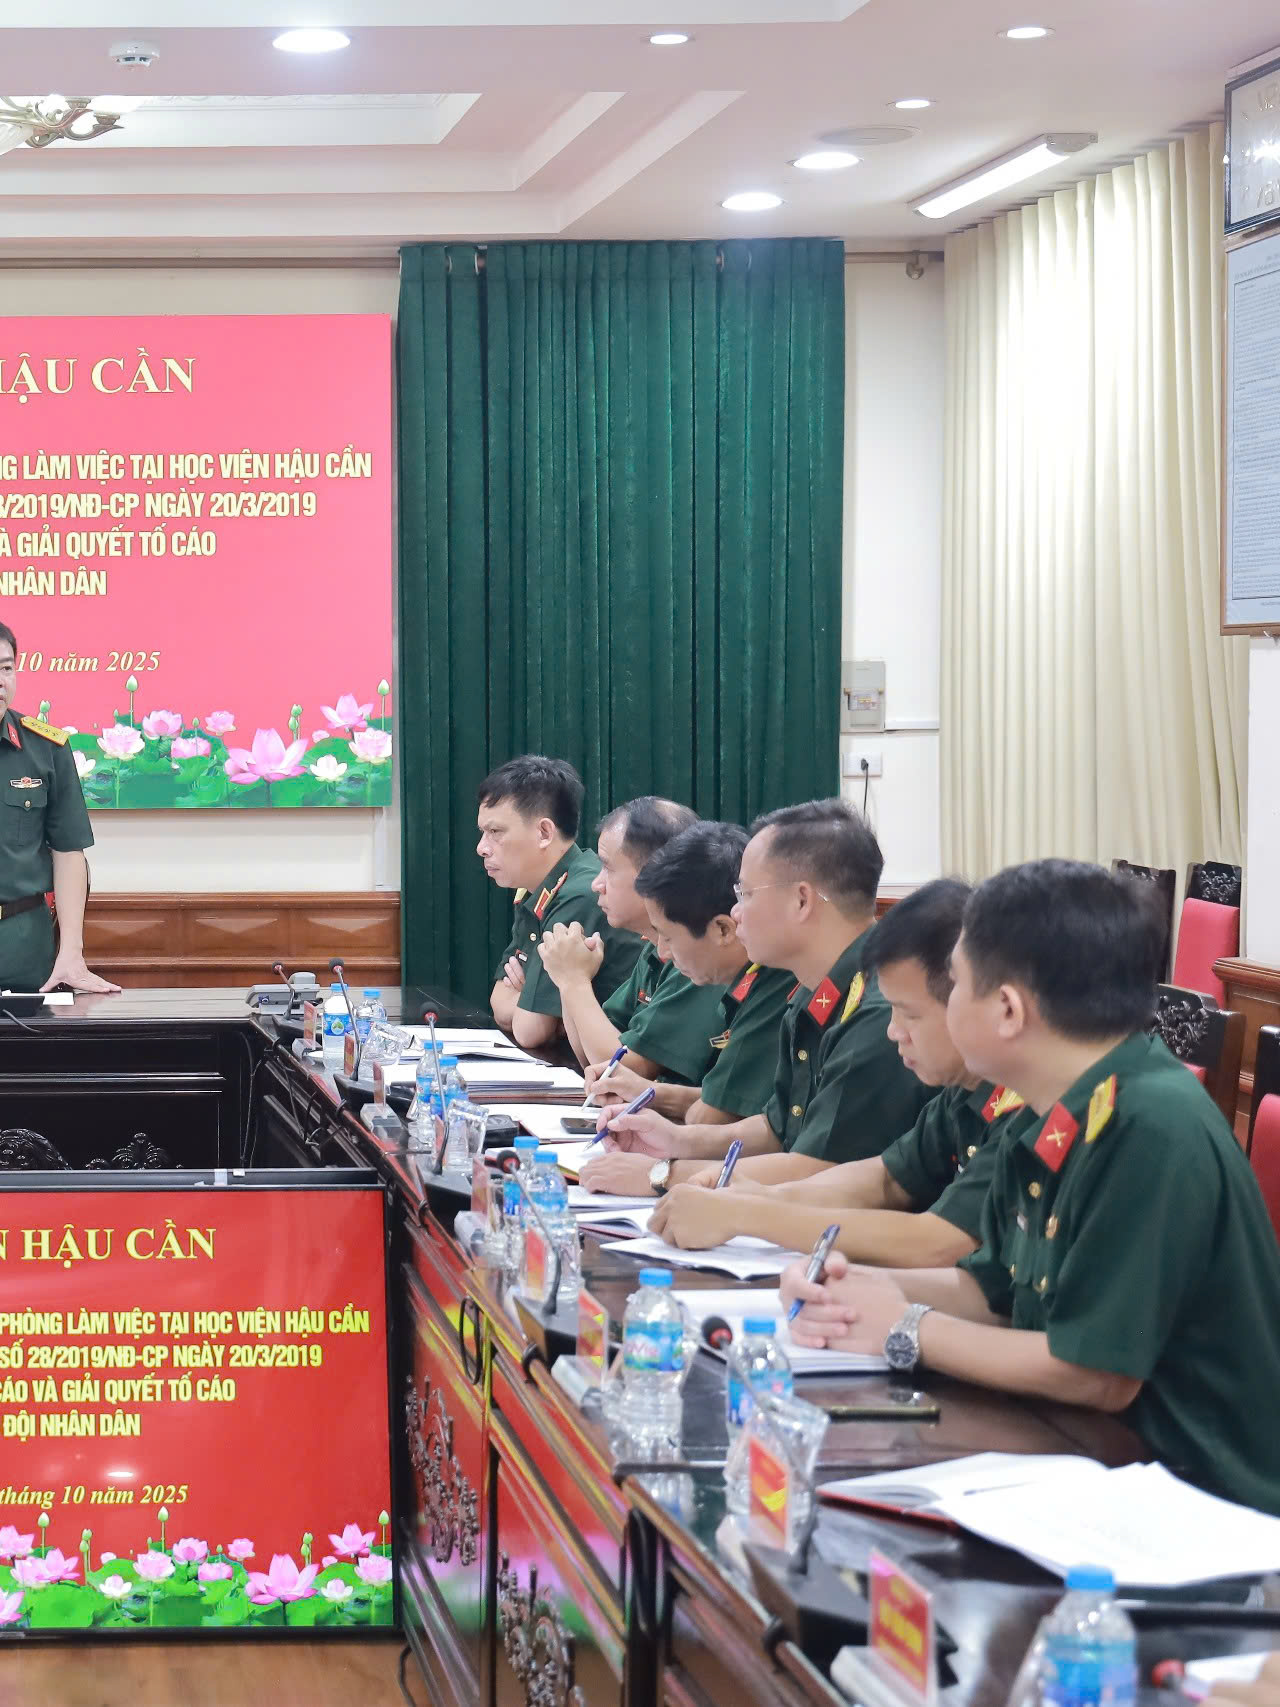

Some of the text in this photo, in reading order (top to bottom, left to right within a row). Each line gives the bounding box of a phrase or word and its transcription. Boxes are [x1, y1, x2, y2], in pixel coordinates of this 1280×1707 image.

[92, 347, 195, 393] CẦN
[23, 450, 70, 479] LÀM
[76, 450, 124, 485] VIỆC
[130, 455, 163, 484] TẠI
[170, 454, 213, 484] HỌC
[219, 449, 269, 484] VIỆN
[275, 449, 319, 483] HẬU
[326, 444, 371, 478] CẦN
[145, 487, 205, 518] NGÀY
[210, 492, 316, 517] 20/3/2019
[17, 524, 60, 557] GIẢI
[66, 523, 134, 559] QUYẾT
[139, 523, 166, 556] TỐ
[172, 527, 216, 556] CÁO
[60, 566, 106, 595] DÂN
[16, 652, 42, 672] 10
[49, 653, 98, 672] năm
[106, 652, 160, 672] 2025
[21, 1224, 114, 1268] HẬU
[126, 1219, 216, 1259] CẦN
[67, 1308, 109, 1334] LÀM
[113, 1307, 155, 1339] VIỆC
[160, 1312, 189, 1338] TẠI
[194, 1311, 233, 1338] HỌC
[237, 1307, 281, 1338] VIỆN
[285, 1306, 324, 1338] HẬU
[329, 1303, 369, 1333] CẦN
[27, 1345, 167, 1368] 28/2019/NĐ-CP
[172, 1340, 225, 1367] NGÀY
[229, 1344, 322, 1367] 20/3/2019
[32, 1375, 58, 1402] VÀ
[62, 1372, 100, 1402] GIẢI
[105, 1372, 164, 1404] QUYẾT
[168, 1371, 192, 1402] TỐ
[197, 1374, 235, 1402] CÁO
[3, 1410, 35, 1442] ĐỘI
[40, 1409, 95, 1436] NHÂN
[100, 1409, 140, 1436] DÂN
[61, 1486, 85, 1504] 10
[90, 1486, 134, 1504] năm
[140, 1485, 188, 1504] 2025
